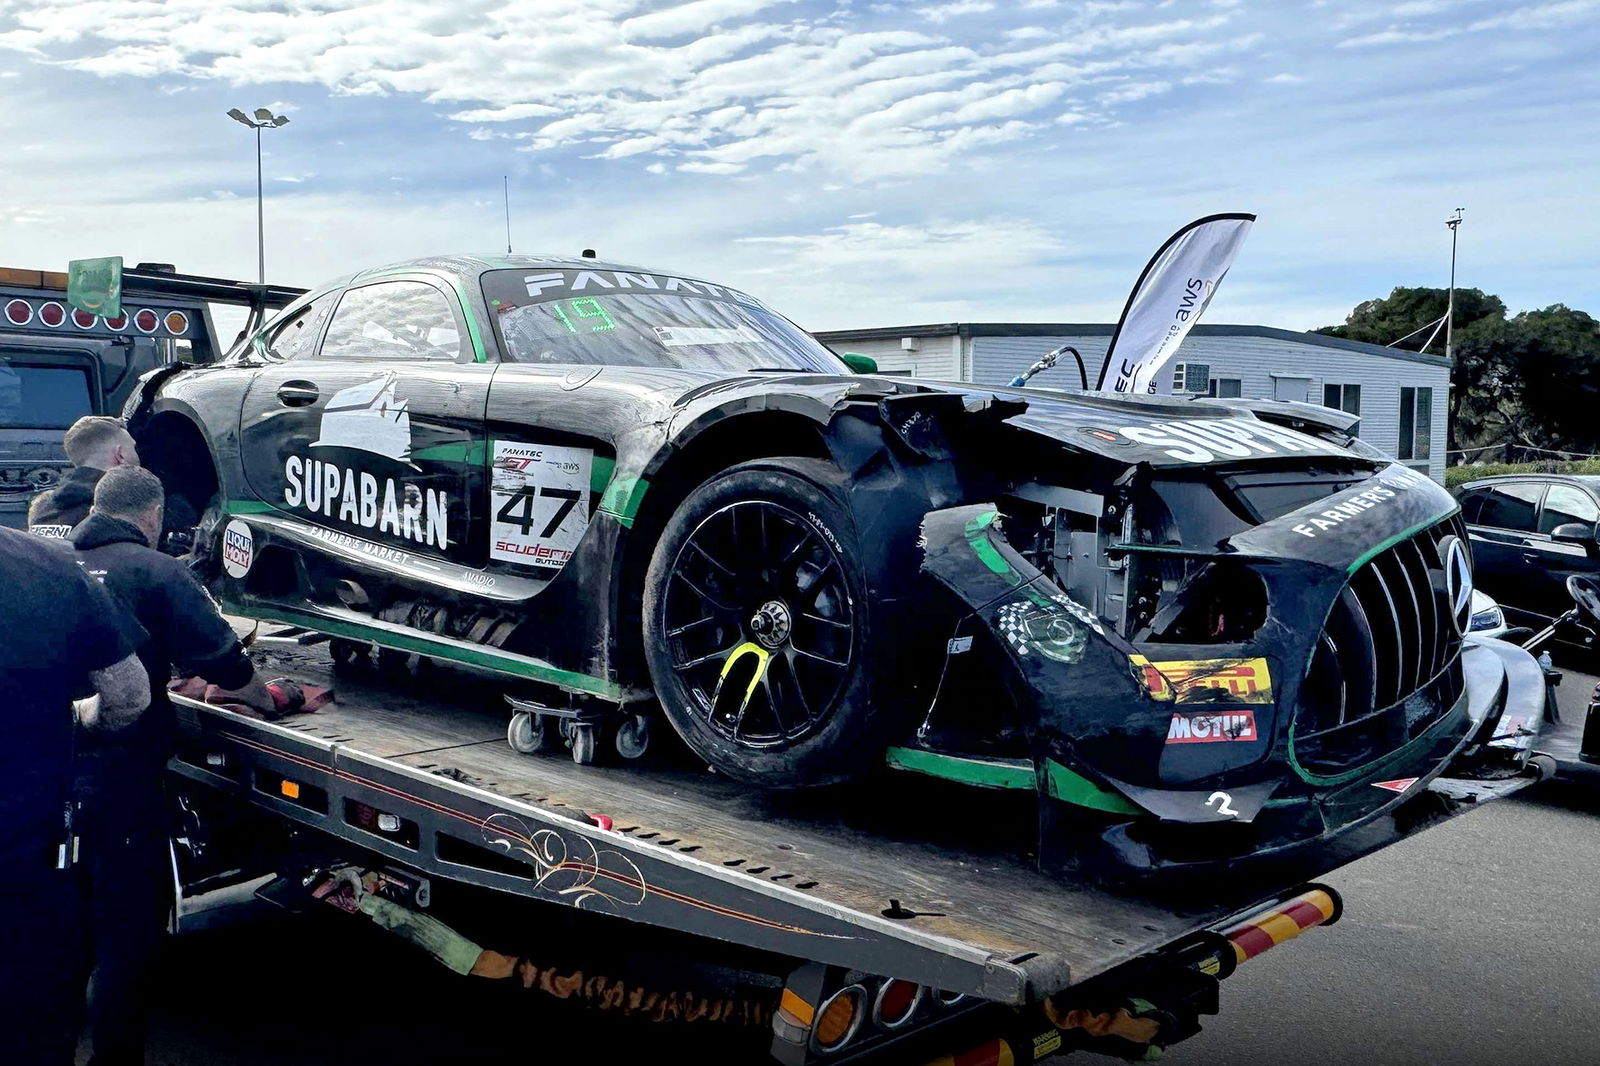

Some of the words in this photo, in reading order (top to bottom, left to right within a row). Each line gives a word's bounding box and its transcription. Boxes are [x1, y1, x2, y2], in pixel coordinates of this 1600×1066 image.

[554, 296, 617, 334] 19
[1175, 278, 1203, 322] aws
[501, 447, 543, 458] FANATEC
[284, 455, 448, 550] SUPABARN
[496, 484, 582, 539] 47
[1291, 484, 1396, 537] FARMER'S
[309, 525, 361, 549] FARMER'S
[365, 541, 409, 565] MARKET
[1167, 714, 1252, 740] MOTUL
